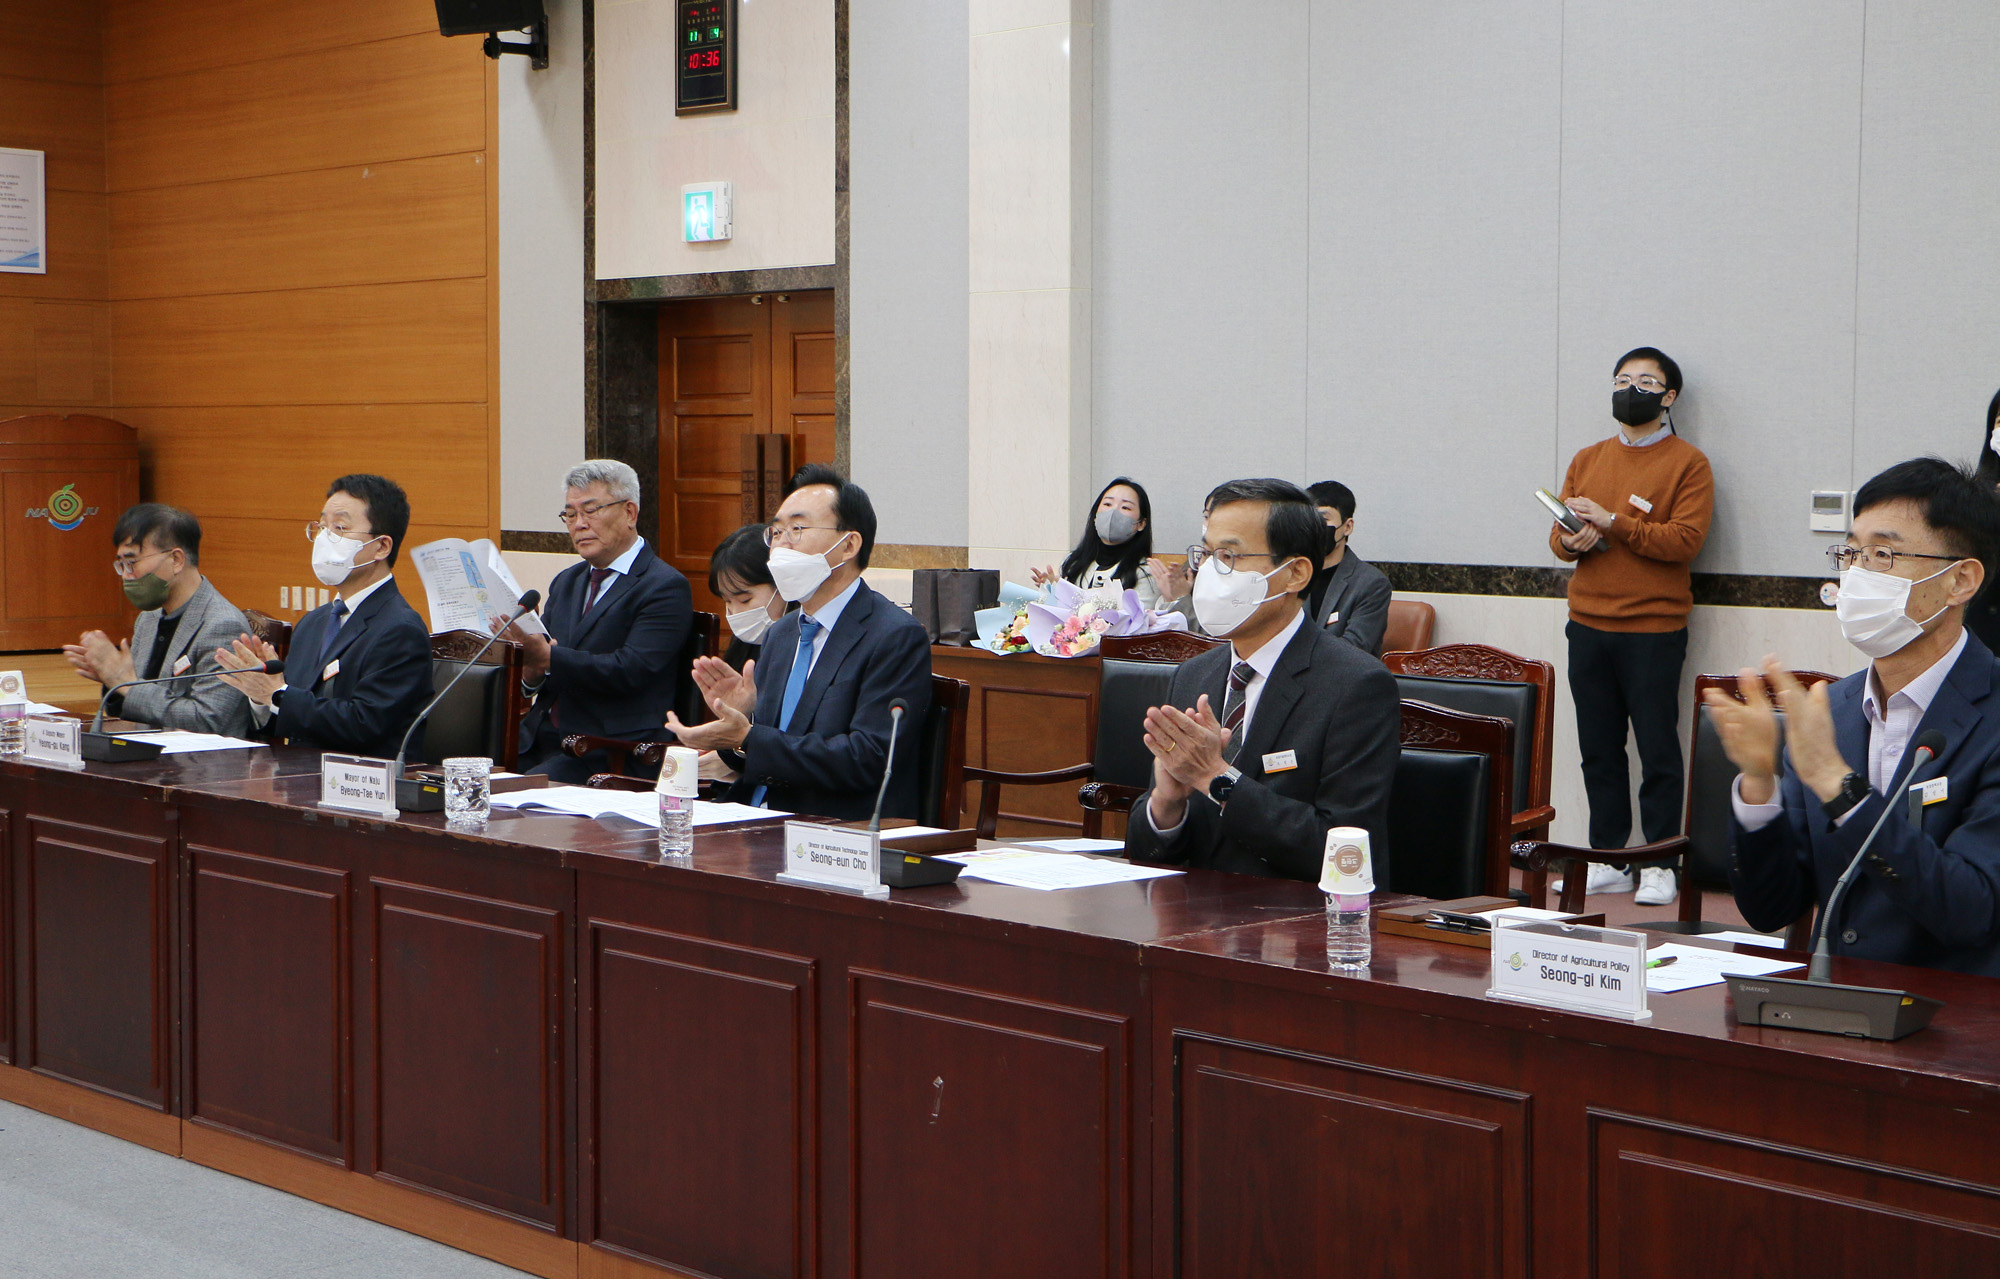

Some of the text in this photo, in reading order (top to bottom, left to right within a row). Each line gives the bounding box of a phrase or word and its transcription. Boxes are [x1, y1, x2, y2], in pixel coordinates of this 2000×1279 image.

[689, 31, 698, 42] 11
[688, 50, 720, 69] 10:36
[344, 773, 381, 785] Mayor of Naju
[340, 785, 386, 800] Byeong-Tae Yun
[810, 850, 867, 871] Seong-eun Cho
[1532, 949, 1631, 974] Director of Agricultural Policy
[1540, 965, 1622, 991] Seong-gi Kim
